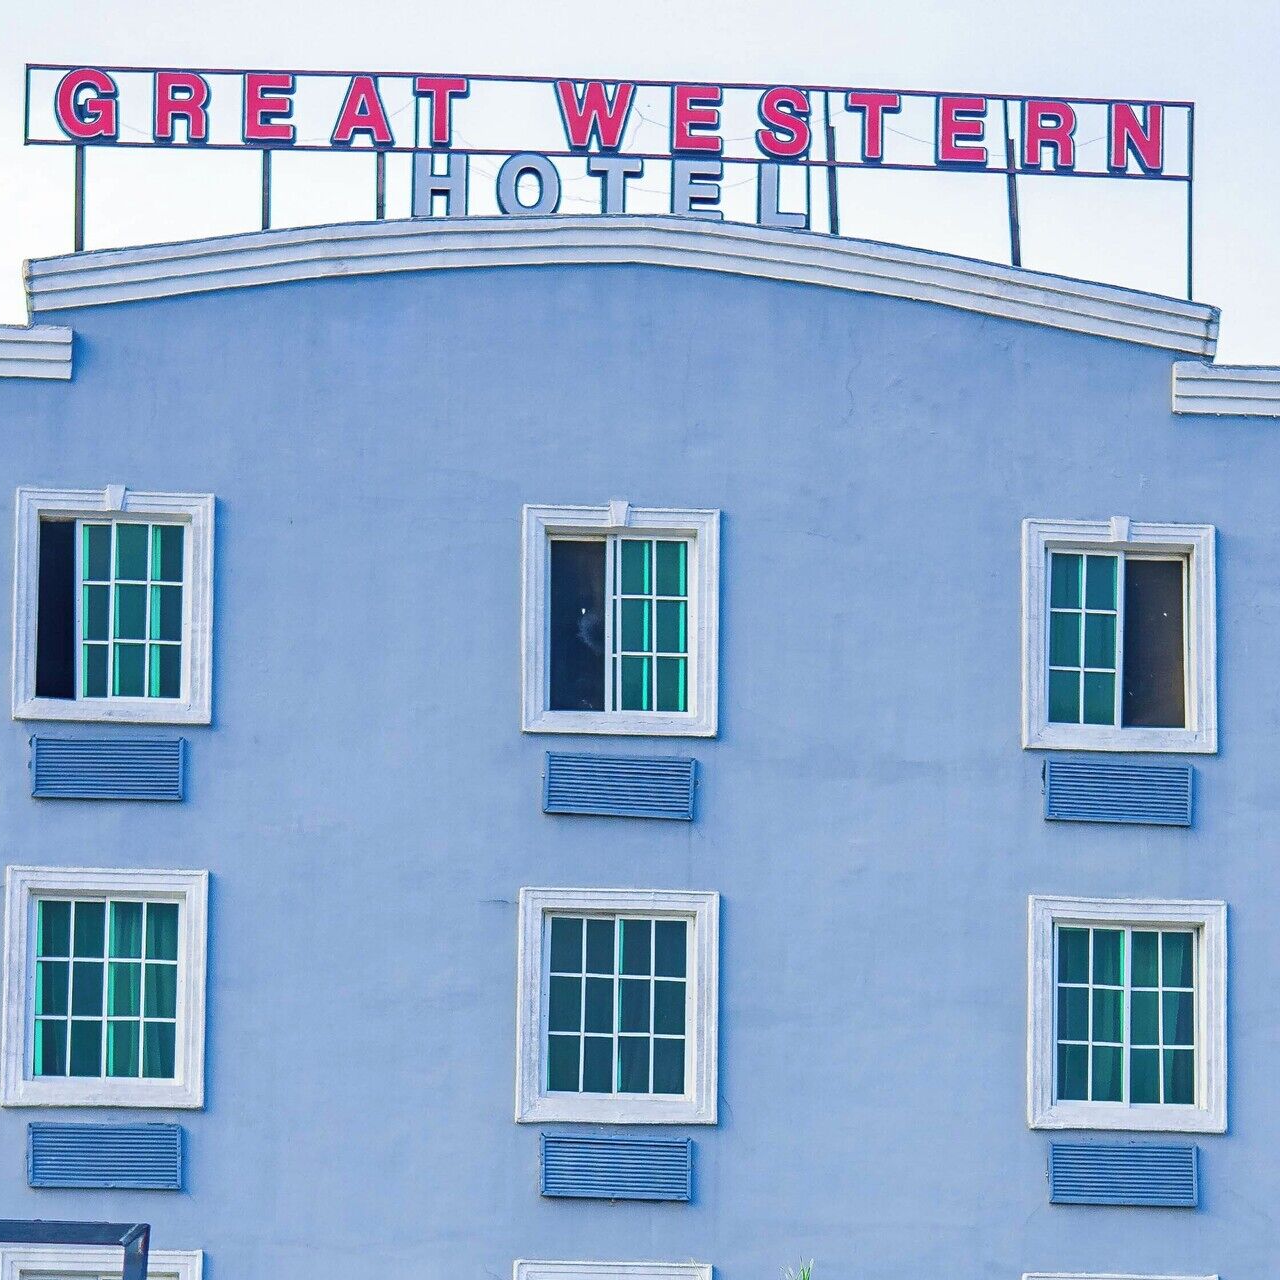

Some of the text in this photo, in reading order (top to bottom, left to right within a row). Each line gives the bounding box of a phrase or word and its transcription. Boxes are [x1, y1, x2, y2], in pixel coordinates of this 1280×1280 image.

[55, 68, 1165, 173] GREAT WESTERN
[412, 152, 810, 229] HOTEL
